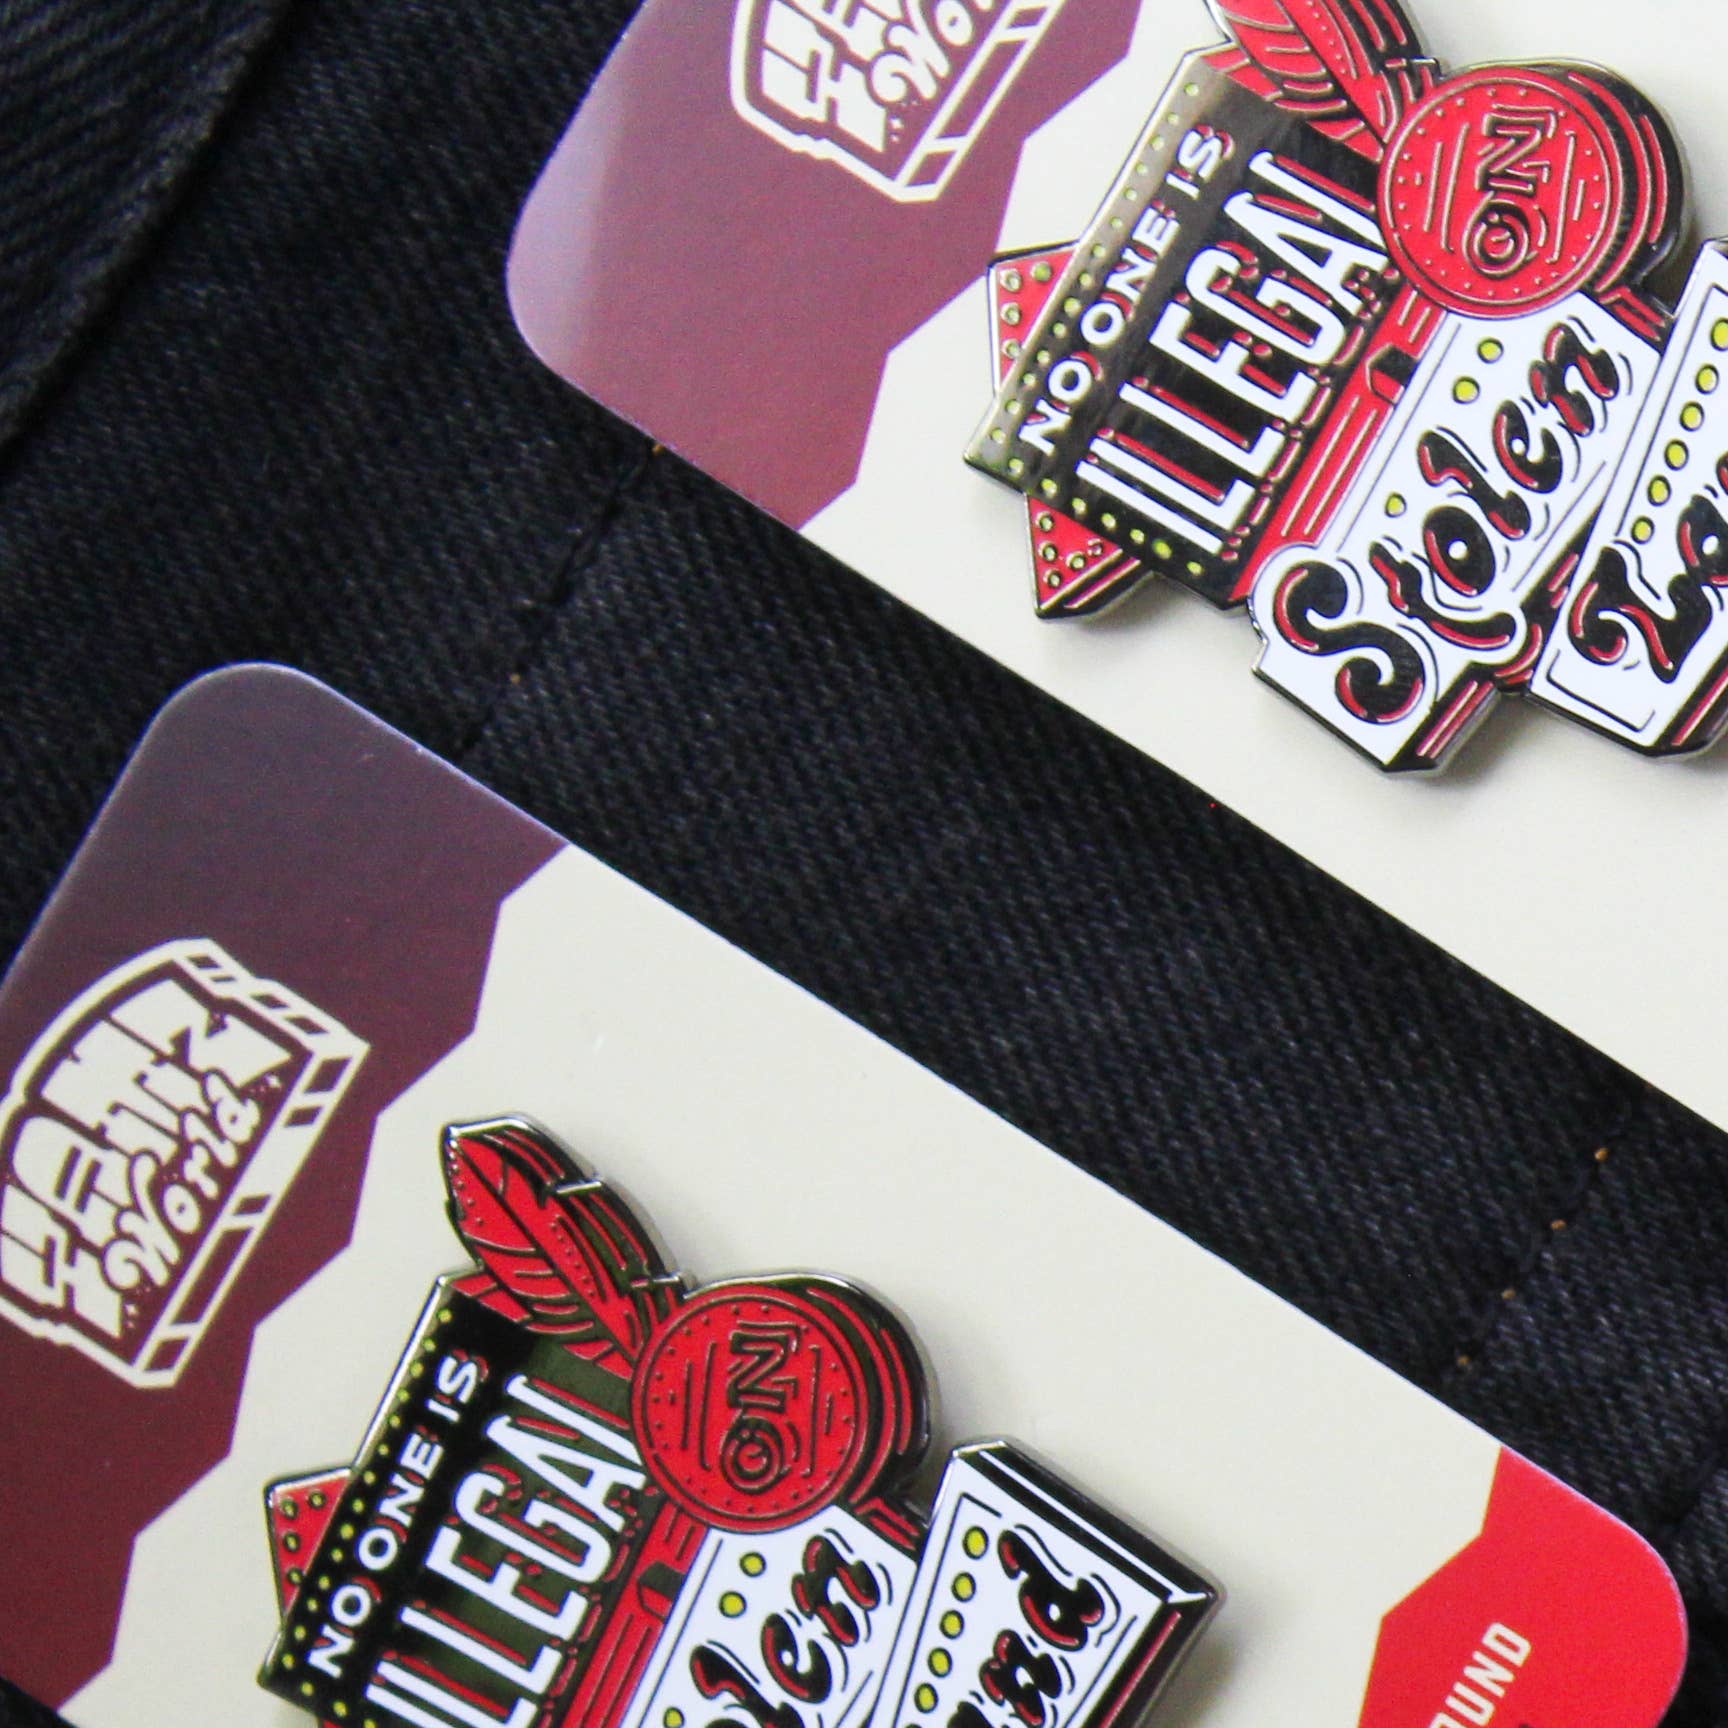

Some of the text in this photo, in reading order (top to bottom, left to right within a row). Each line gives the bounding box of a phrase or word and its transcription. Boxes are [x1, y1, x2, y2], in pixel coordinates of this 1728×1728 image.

[1021, 133, 1225, 455] NO ONE IS
[1466, 117, 1547, 280] ON
[1274, 323, 1620, 724] Stolen
[106, 1073, 259, 1287] World
[309, 1357, 480, 1678] NO ONE IS
[721, 1334, 789, 1494] ON
